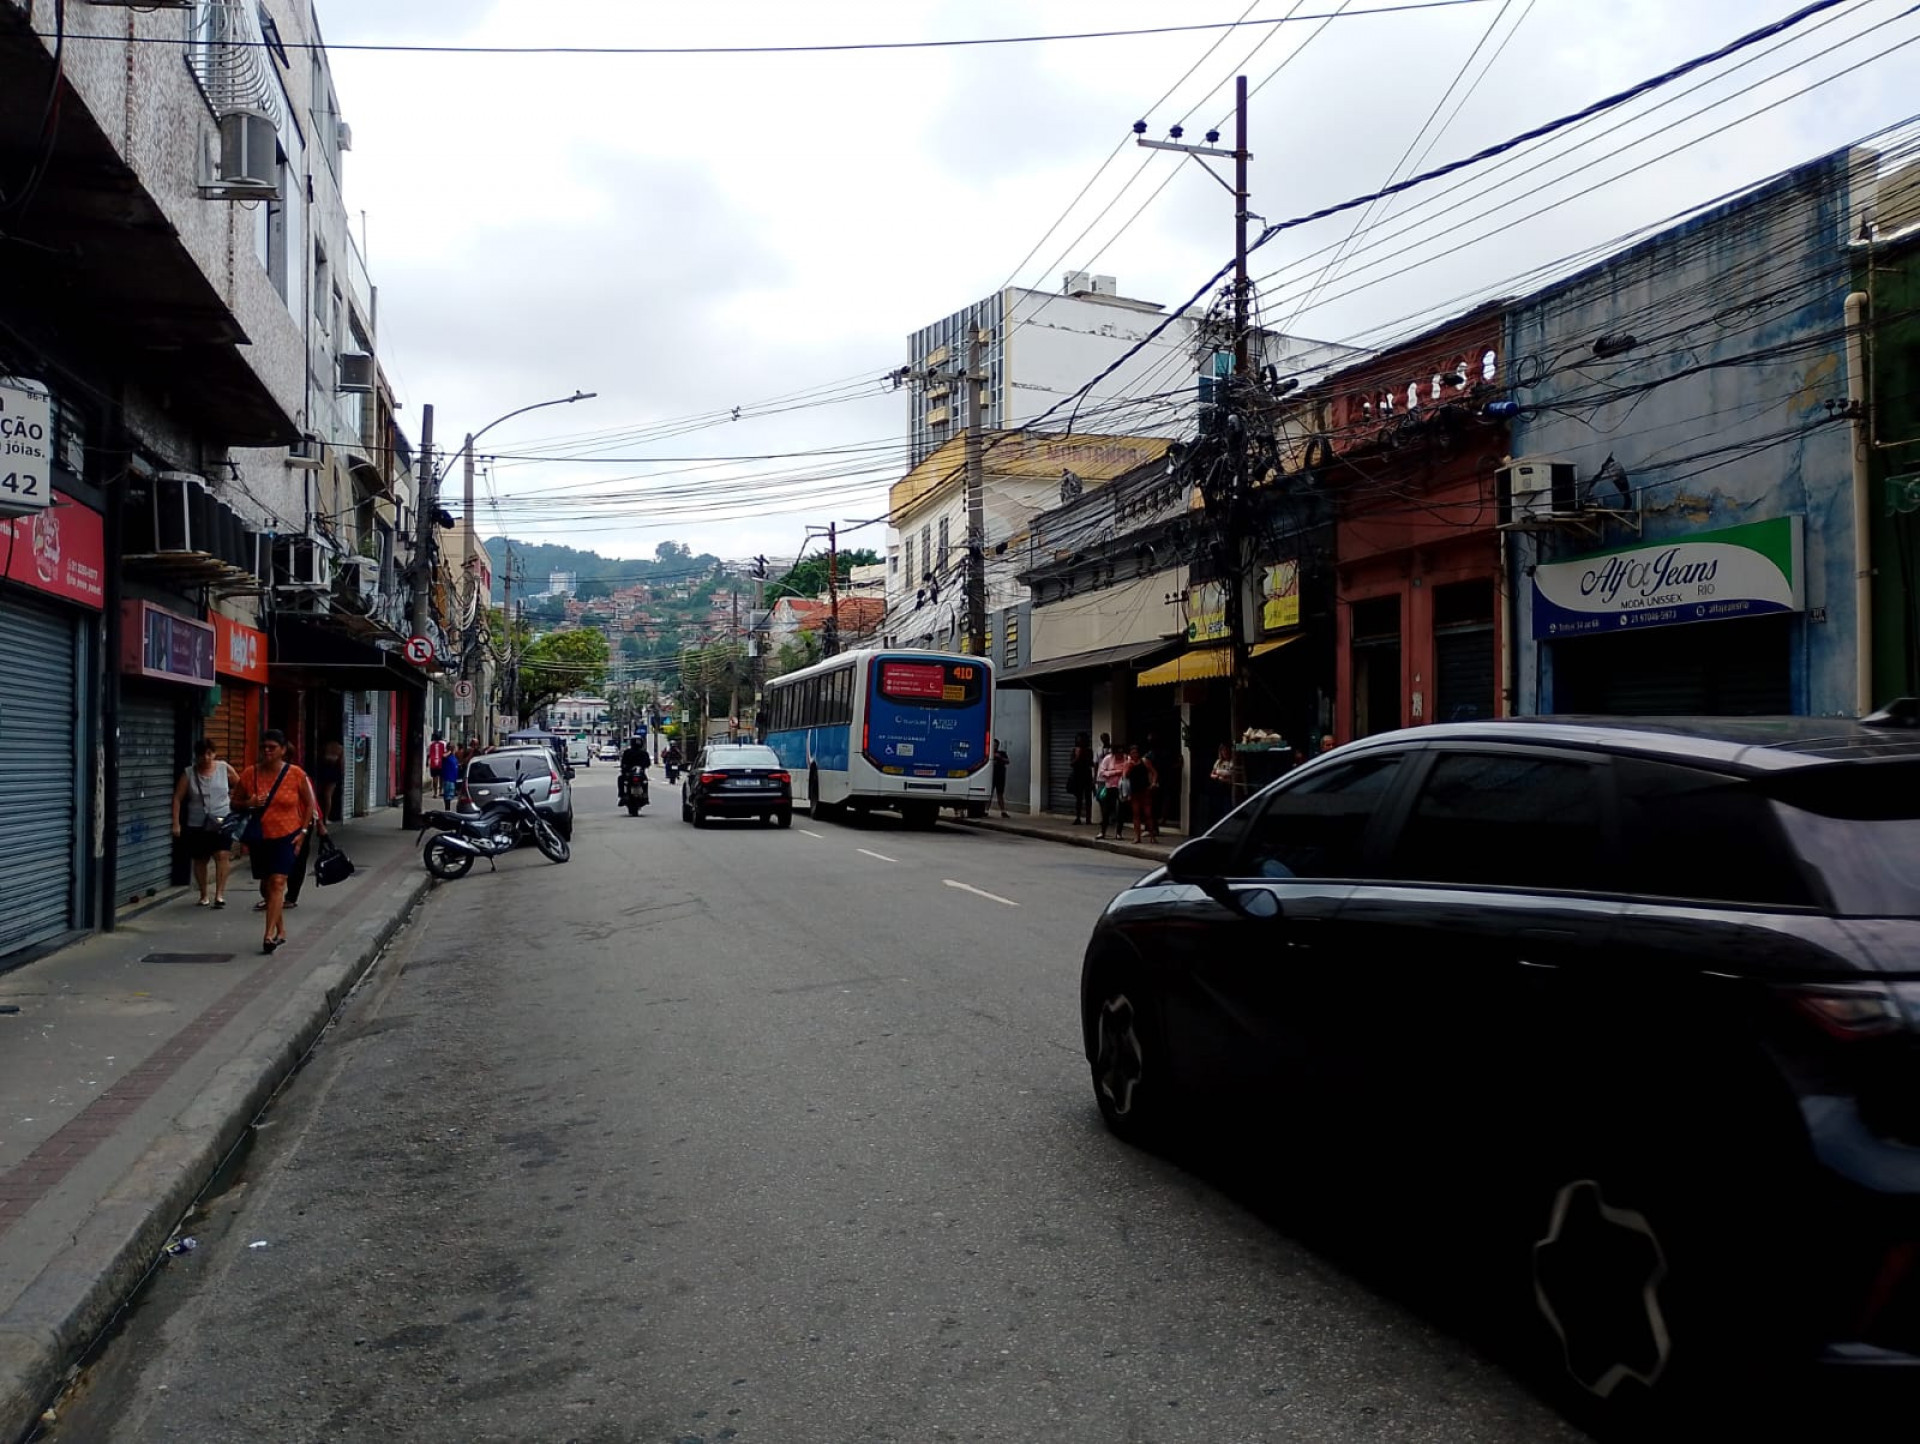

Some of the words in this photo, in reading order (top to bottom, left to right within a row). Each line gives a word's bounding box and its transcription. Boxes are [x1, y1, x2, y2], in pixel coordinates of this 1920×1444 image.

[5, 441, 45, 459] jóias.
[1, 472, 38, 496] 42
[1640, 547, 1718, 597] Jeans
[1697, 583, 1716, 596] RIO
[1621, 599, 1645, 609] MODA
[1647, 593, 1682, 607] UNISSEX
[414, 643, 426, 658] E
[953, 667, 973, 680] 410
[461, 685, 468, 694] E
